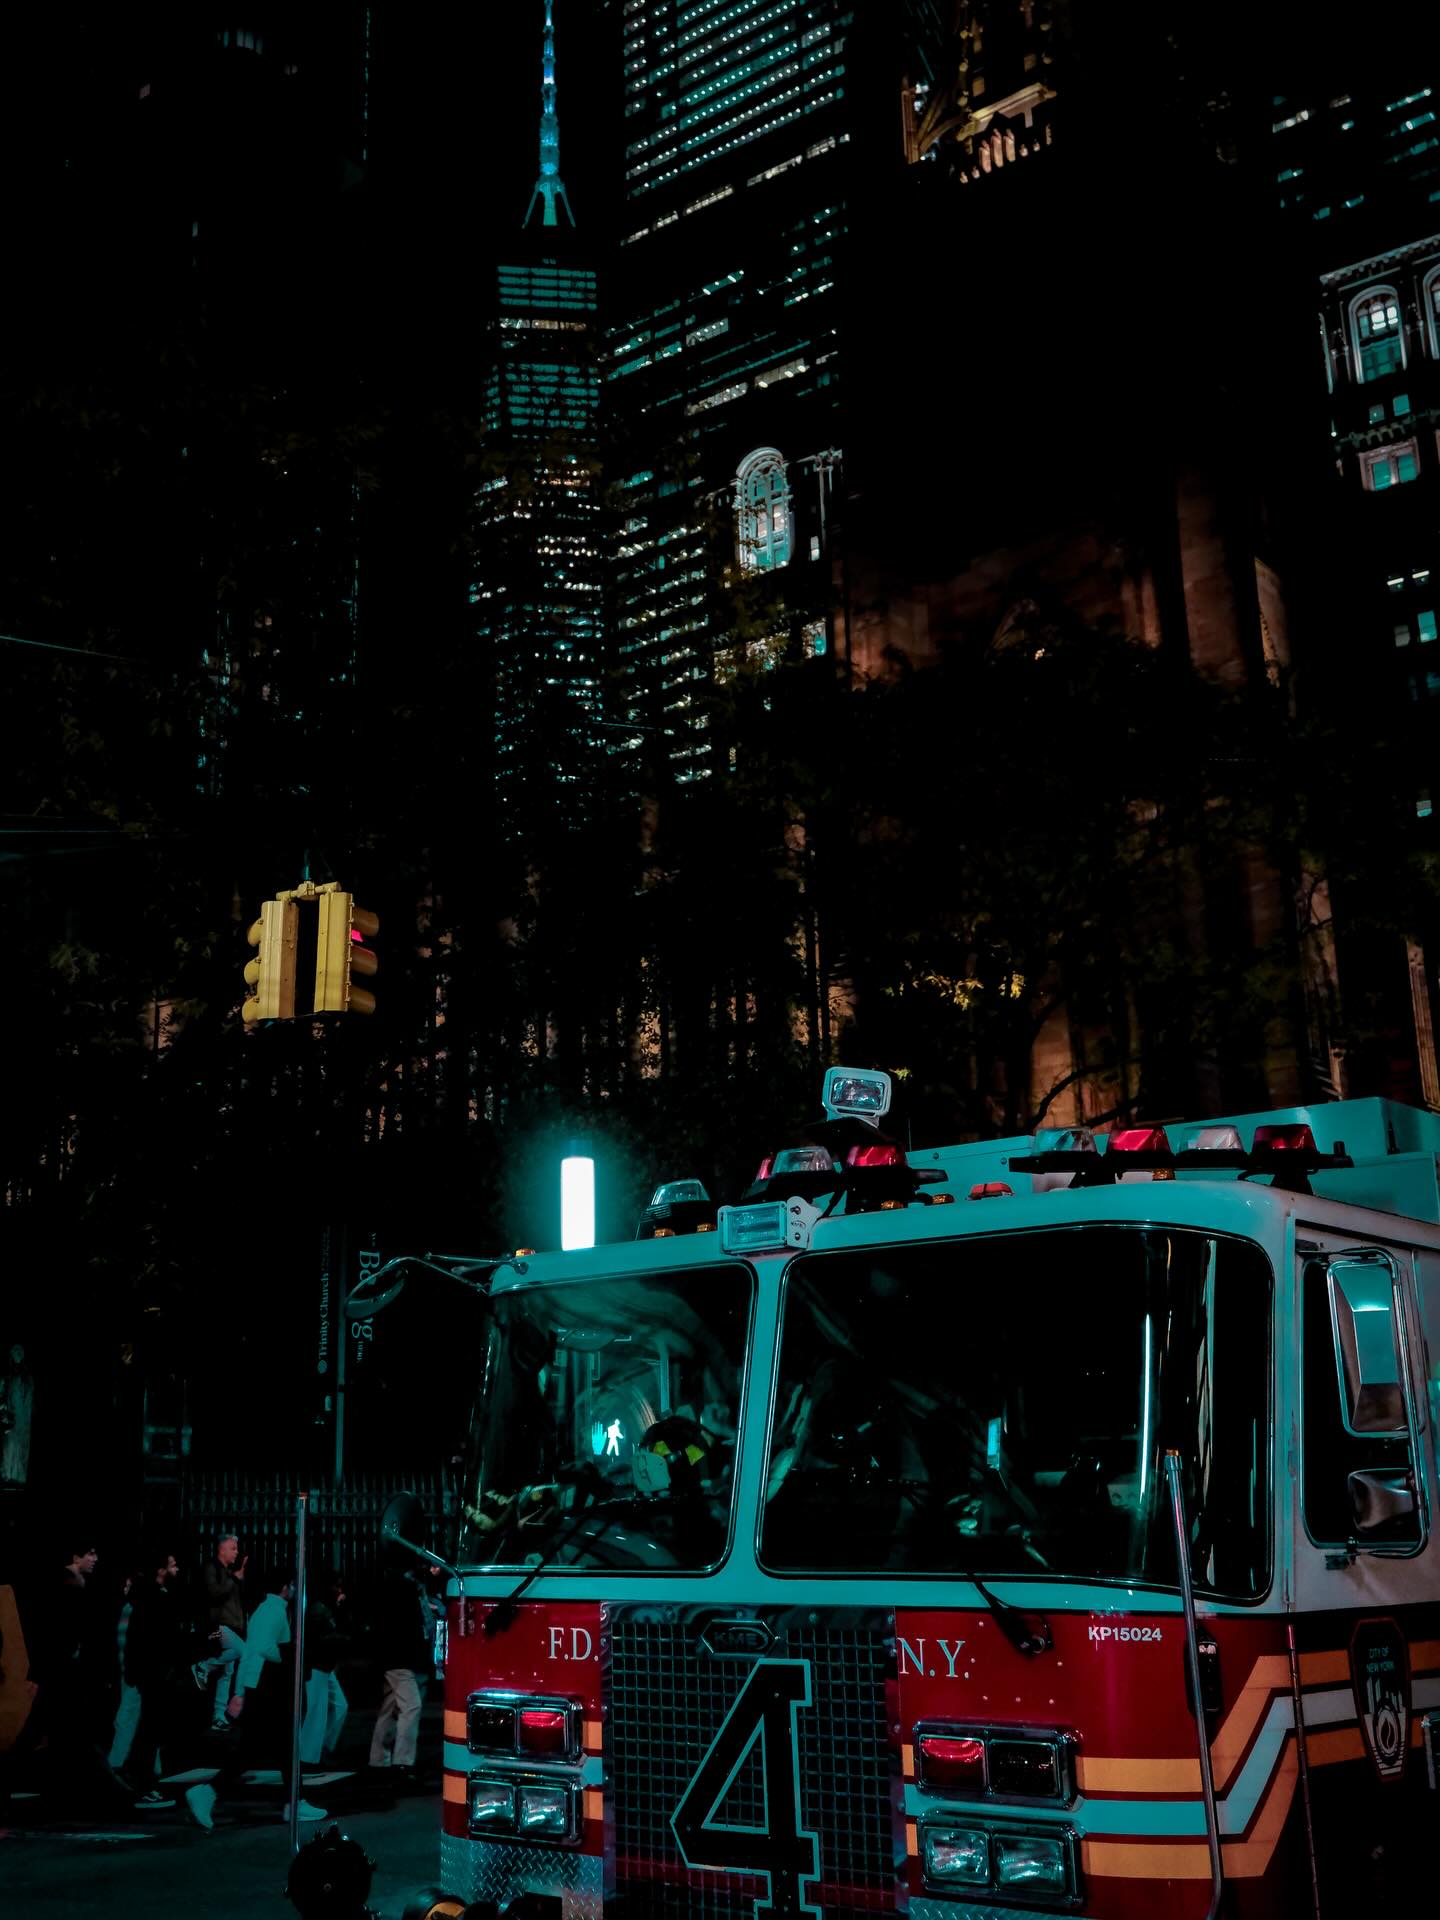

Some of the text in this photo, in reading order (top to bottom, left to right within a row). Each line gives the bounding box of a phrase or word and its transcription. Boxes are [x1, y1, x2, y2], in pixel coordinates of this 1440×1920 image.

[319, 1273, 329, 1318] Church
[318, 1319, 329, 1359] Trinity
[548, 1627, 599, 1661] F.D.
[1088, 1626, 1162, 1641] KP15024
[897, 1637, 969, 1678] N.Y.
[1366, 1662, 1379, 1673] NEW
[1368, 1648, 1381, 1659] CITY
[669, 1658, 822, 1920] 4
